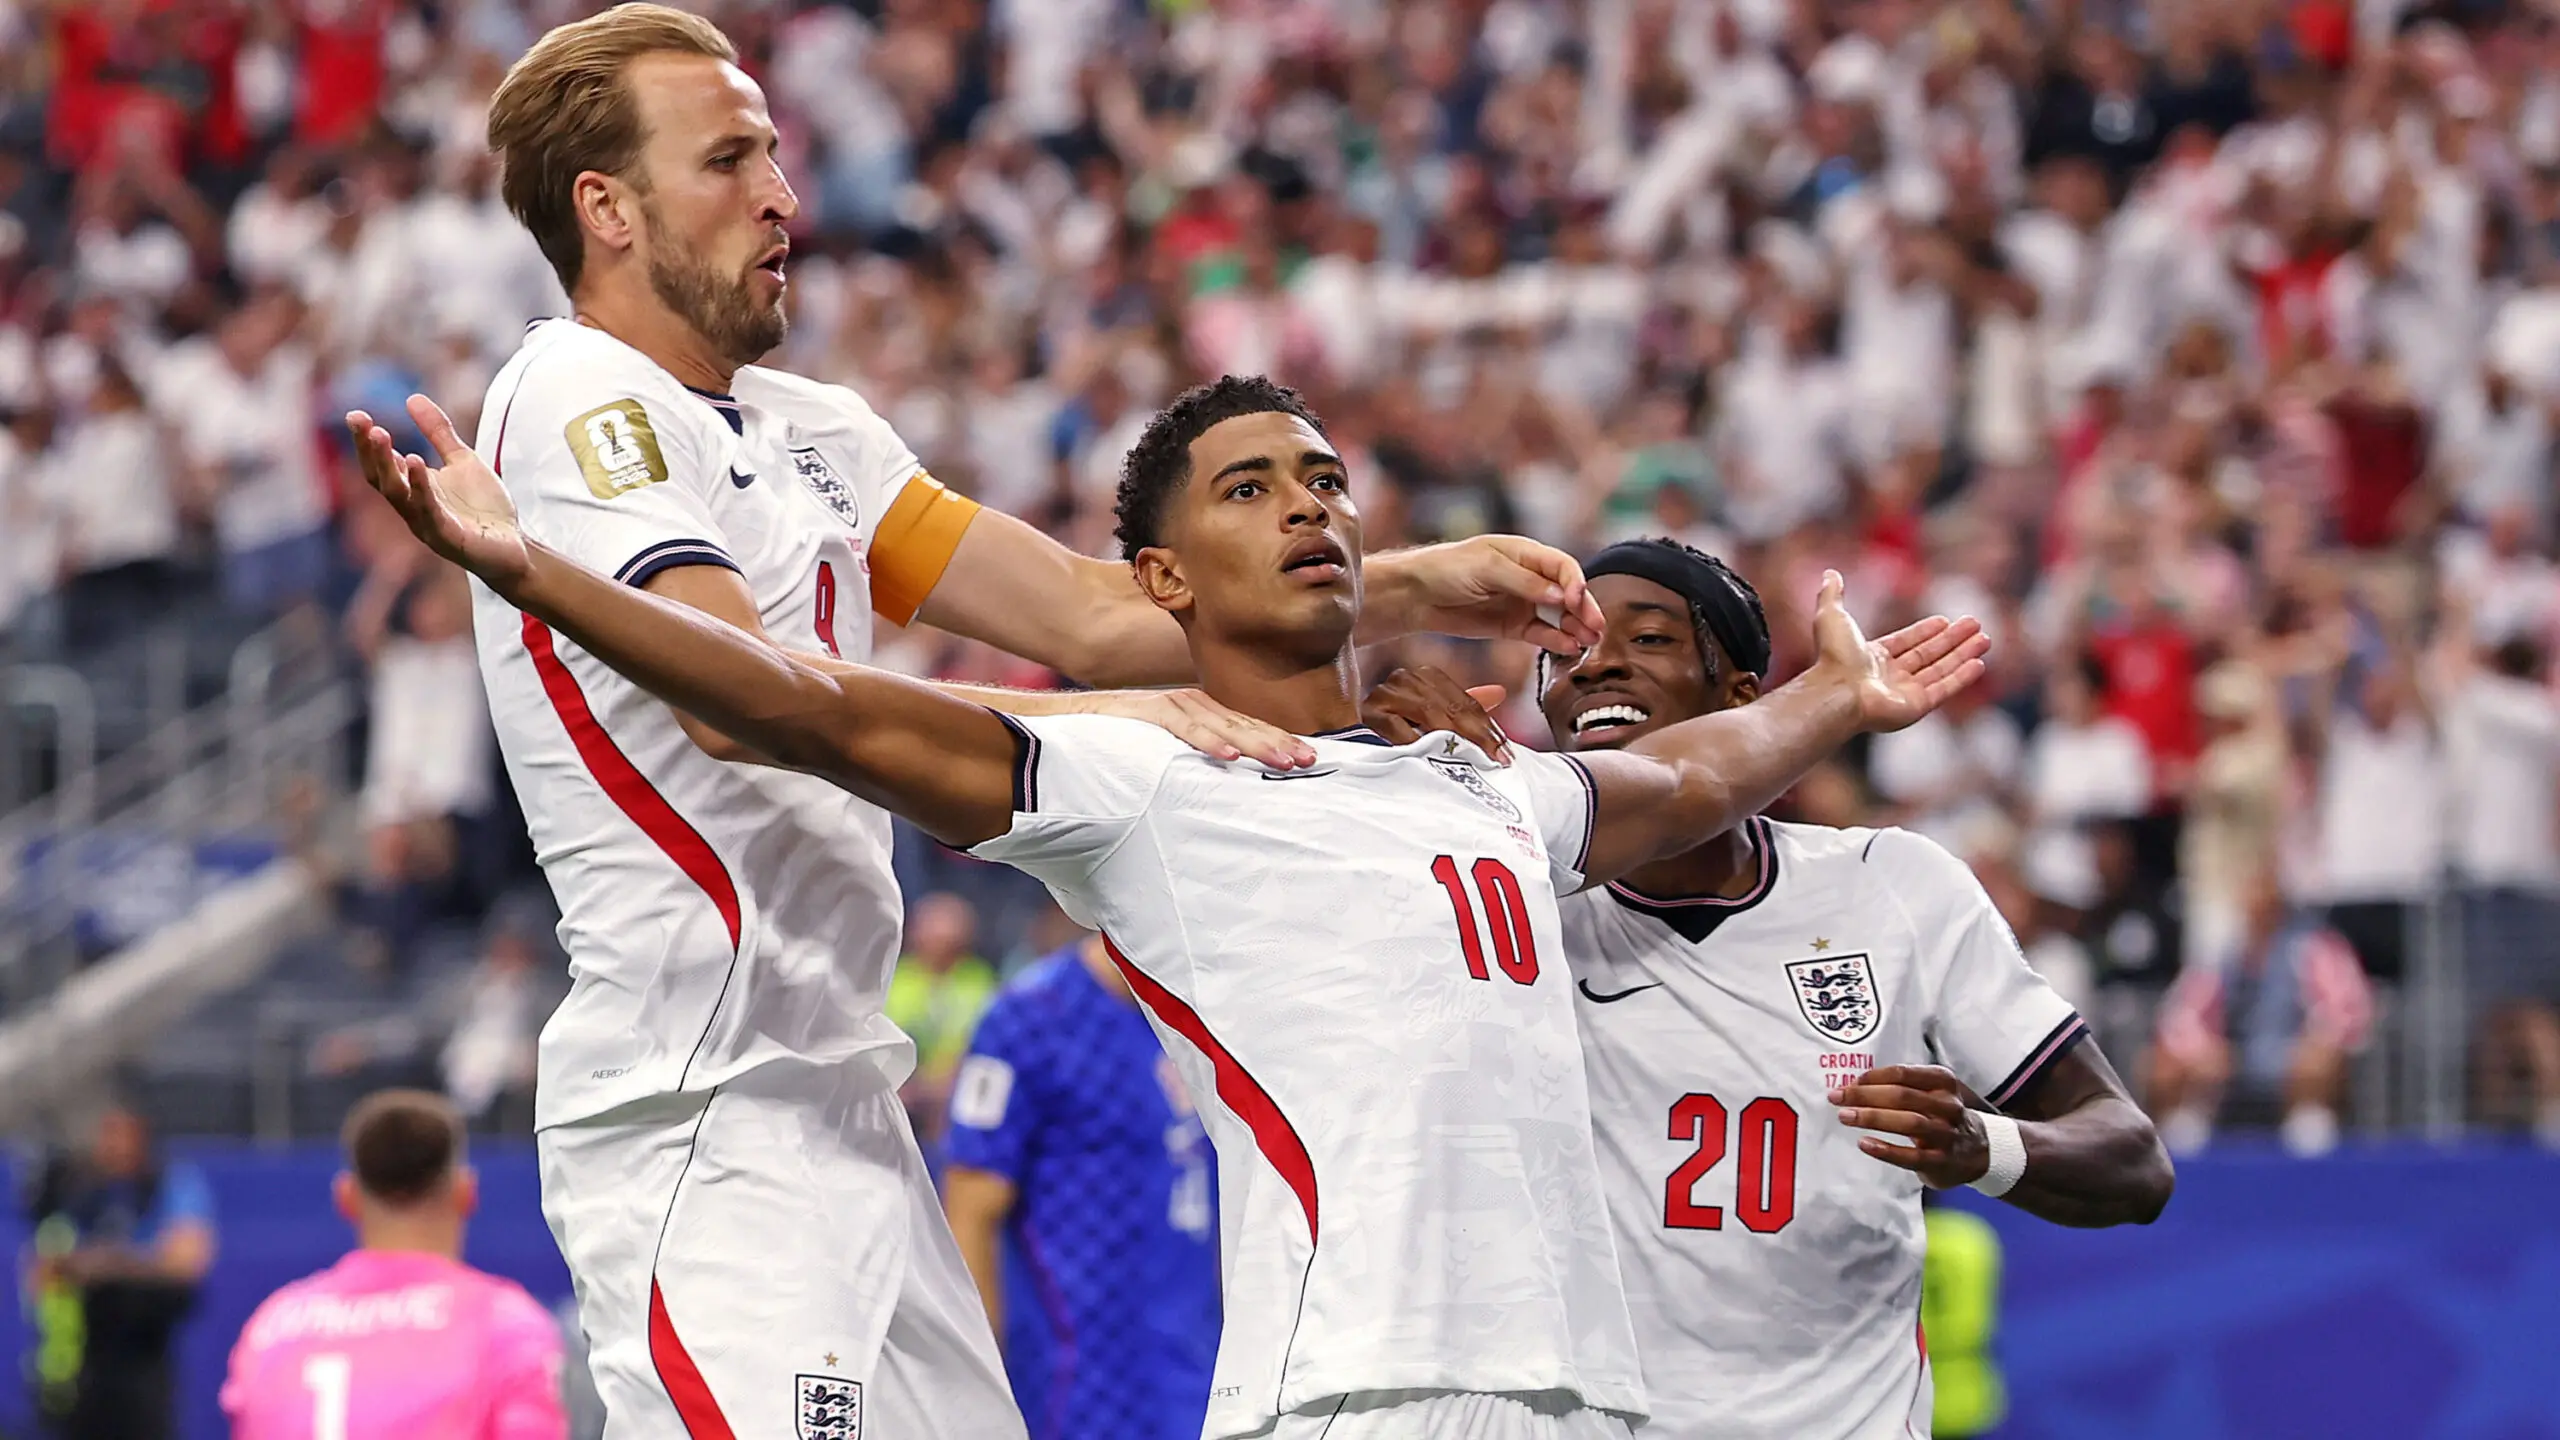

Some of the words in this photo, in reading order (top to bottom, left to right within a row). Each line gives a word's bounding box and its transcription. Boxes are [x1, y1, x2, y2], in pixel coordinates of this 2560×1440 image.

[814, 560, 842, 660] 9
[1430, 854, 1540, 986] 10
[1820, 1053, 1874, 1070] CROATIA
[1663, 1092, 1799, 1234] 20
[302, 1353, 351, 1440] 1
